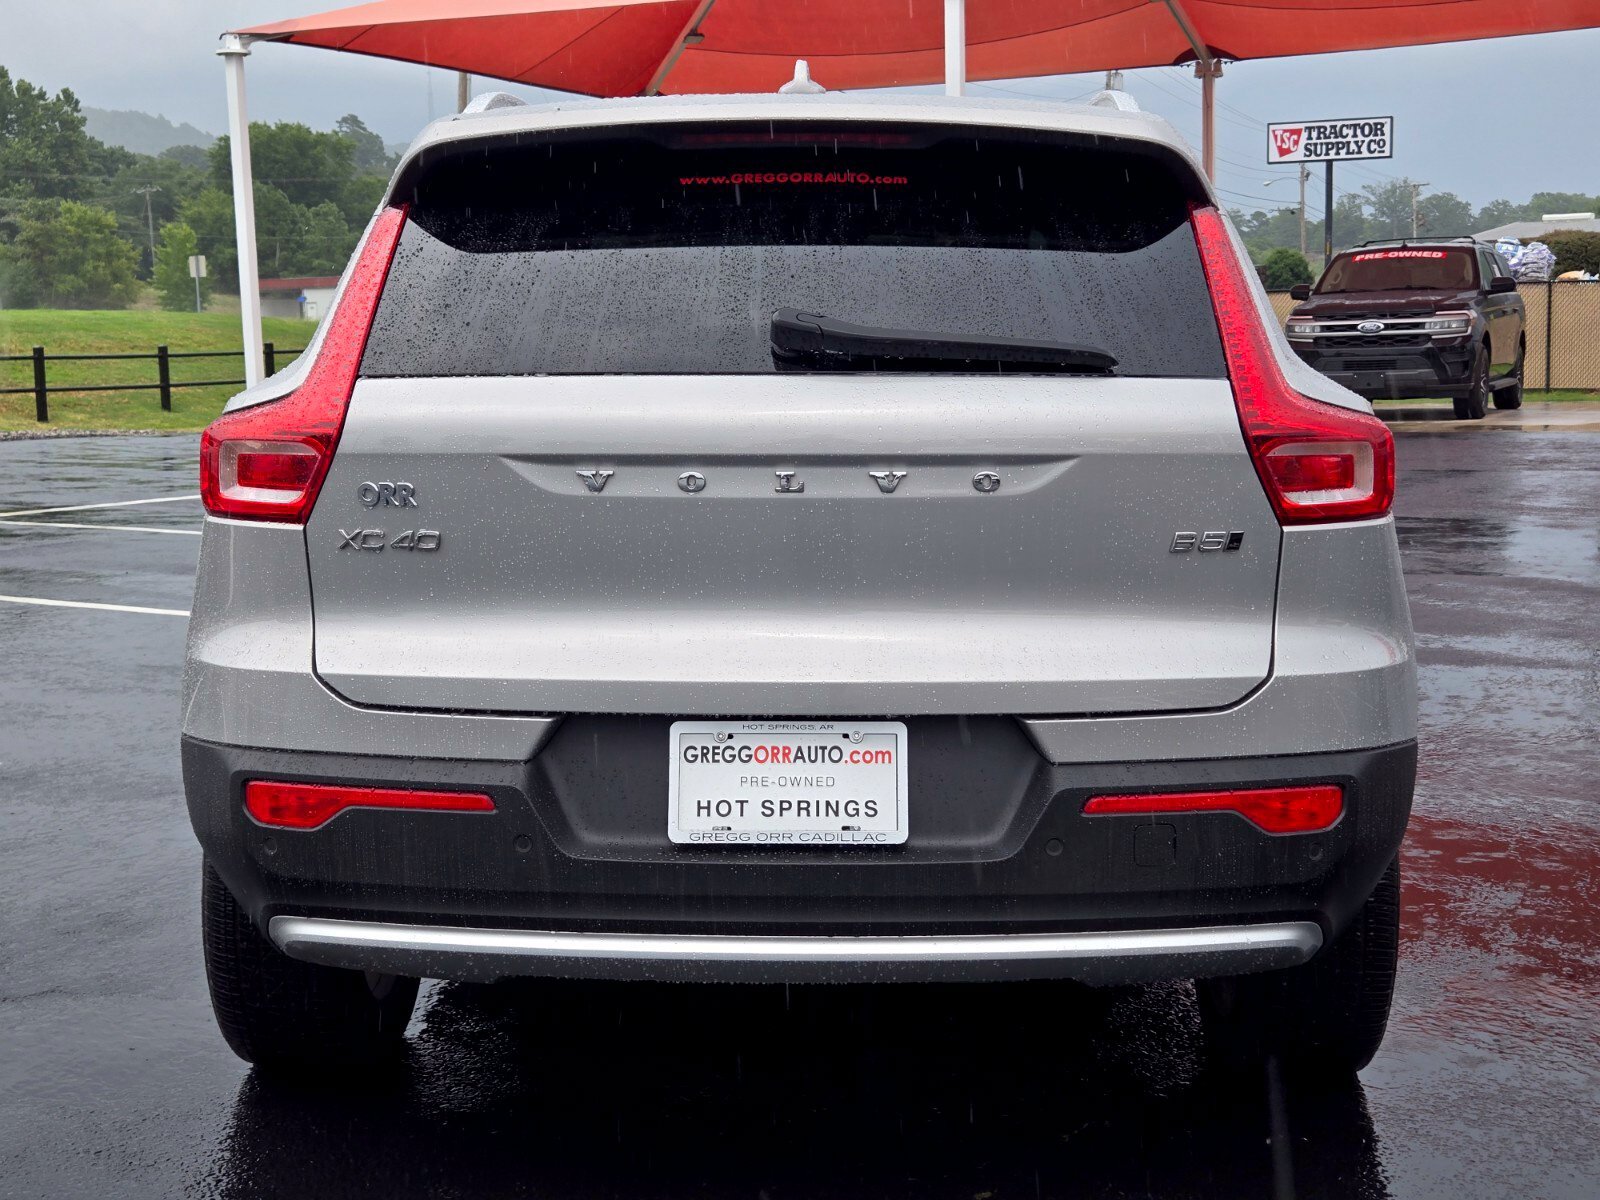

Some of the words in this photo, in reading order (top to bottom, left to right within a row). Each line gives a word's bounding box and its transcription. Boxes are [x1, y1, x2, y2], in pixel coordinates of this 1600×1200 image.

[1304, 122, 1386, 141] TRACTOR
[1274, 130, 1298, 152] TSC
[1303, 140, 1365, 158] SUPPLY
[679, 173, 908, 185] www.GREGGORRAUTO.com
[1355, 251, 1444, 261] PRE-OWNED
[575, 470, 1001, 494] VOLVO
[357, 481, 418, 508] ORR
[1169, 531, 1226, 553] B5
[683, 745, 892, 764] GREGGORRAUTO.com
[740, 776, 835, 788] PRE-OWNED
[696, 800, 749, 818] HOT
[761, 800, 879, 818] SPRINGS
[689, 832, 751, 843] GREGG
[756, 832, 793, 843] ORR
[799, 832, 887, 843] CADILLAC
